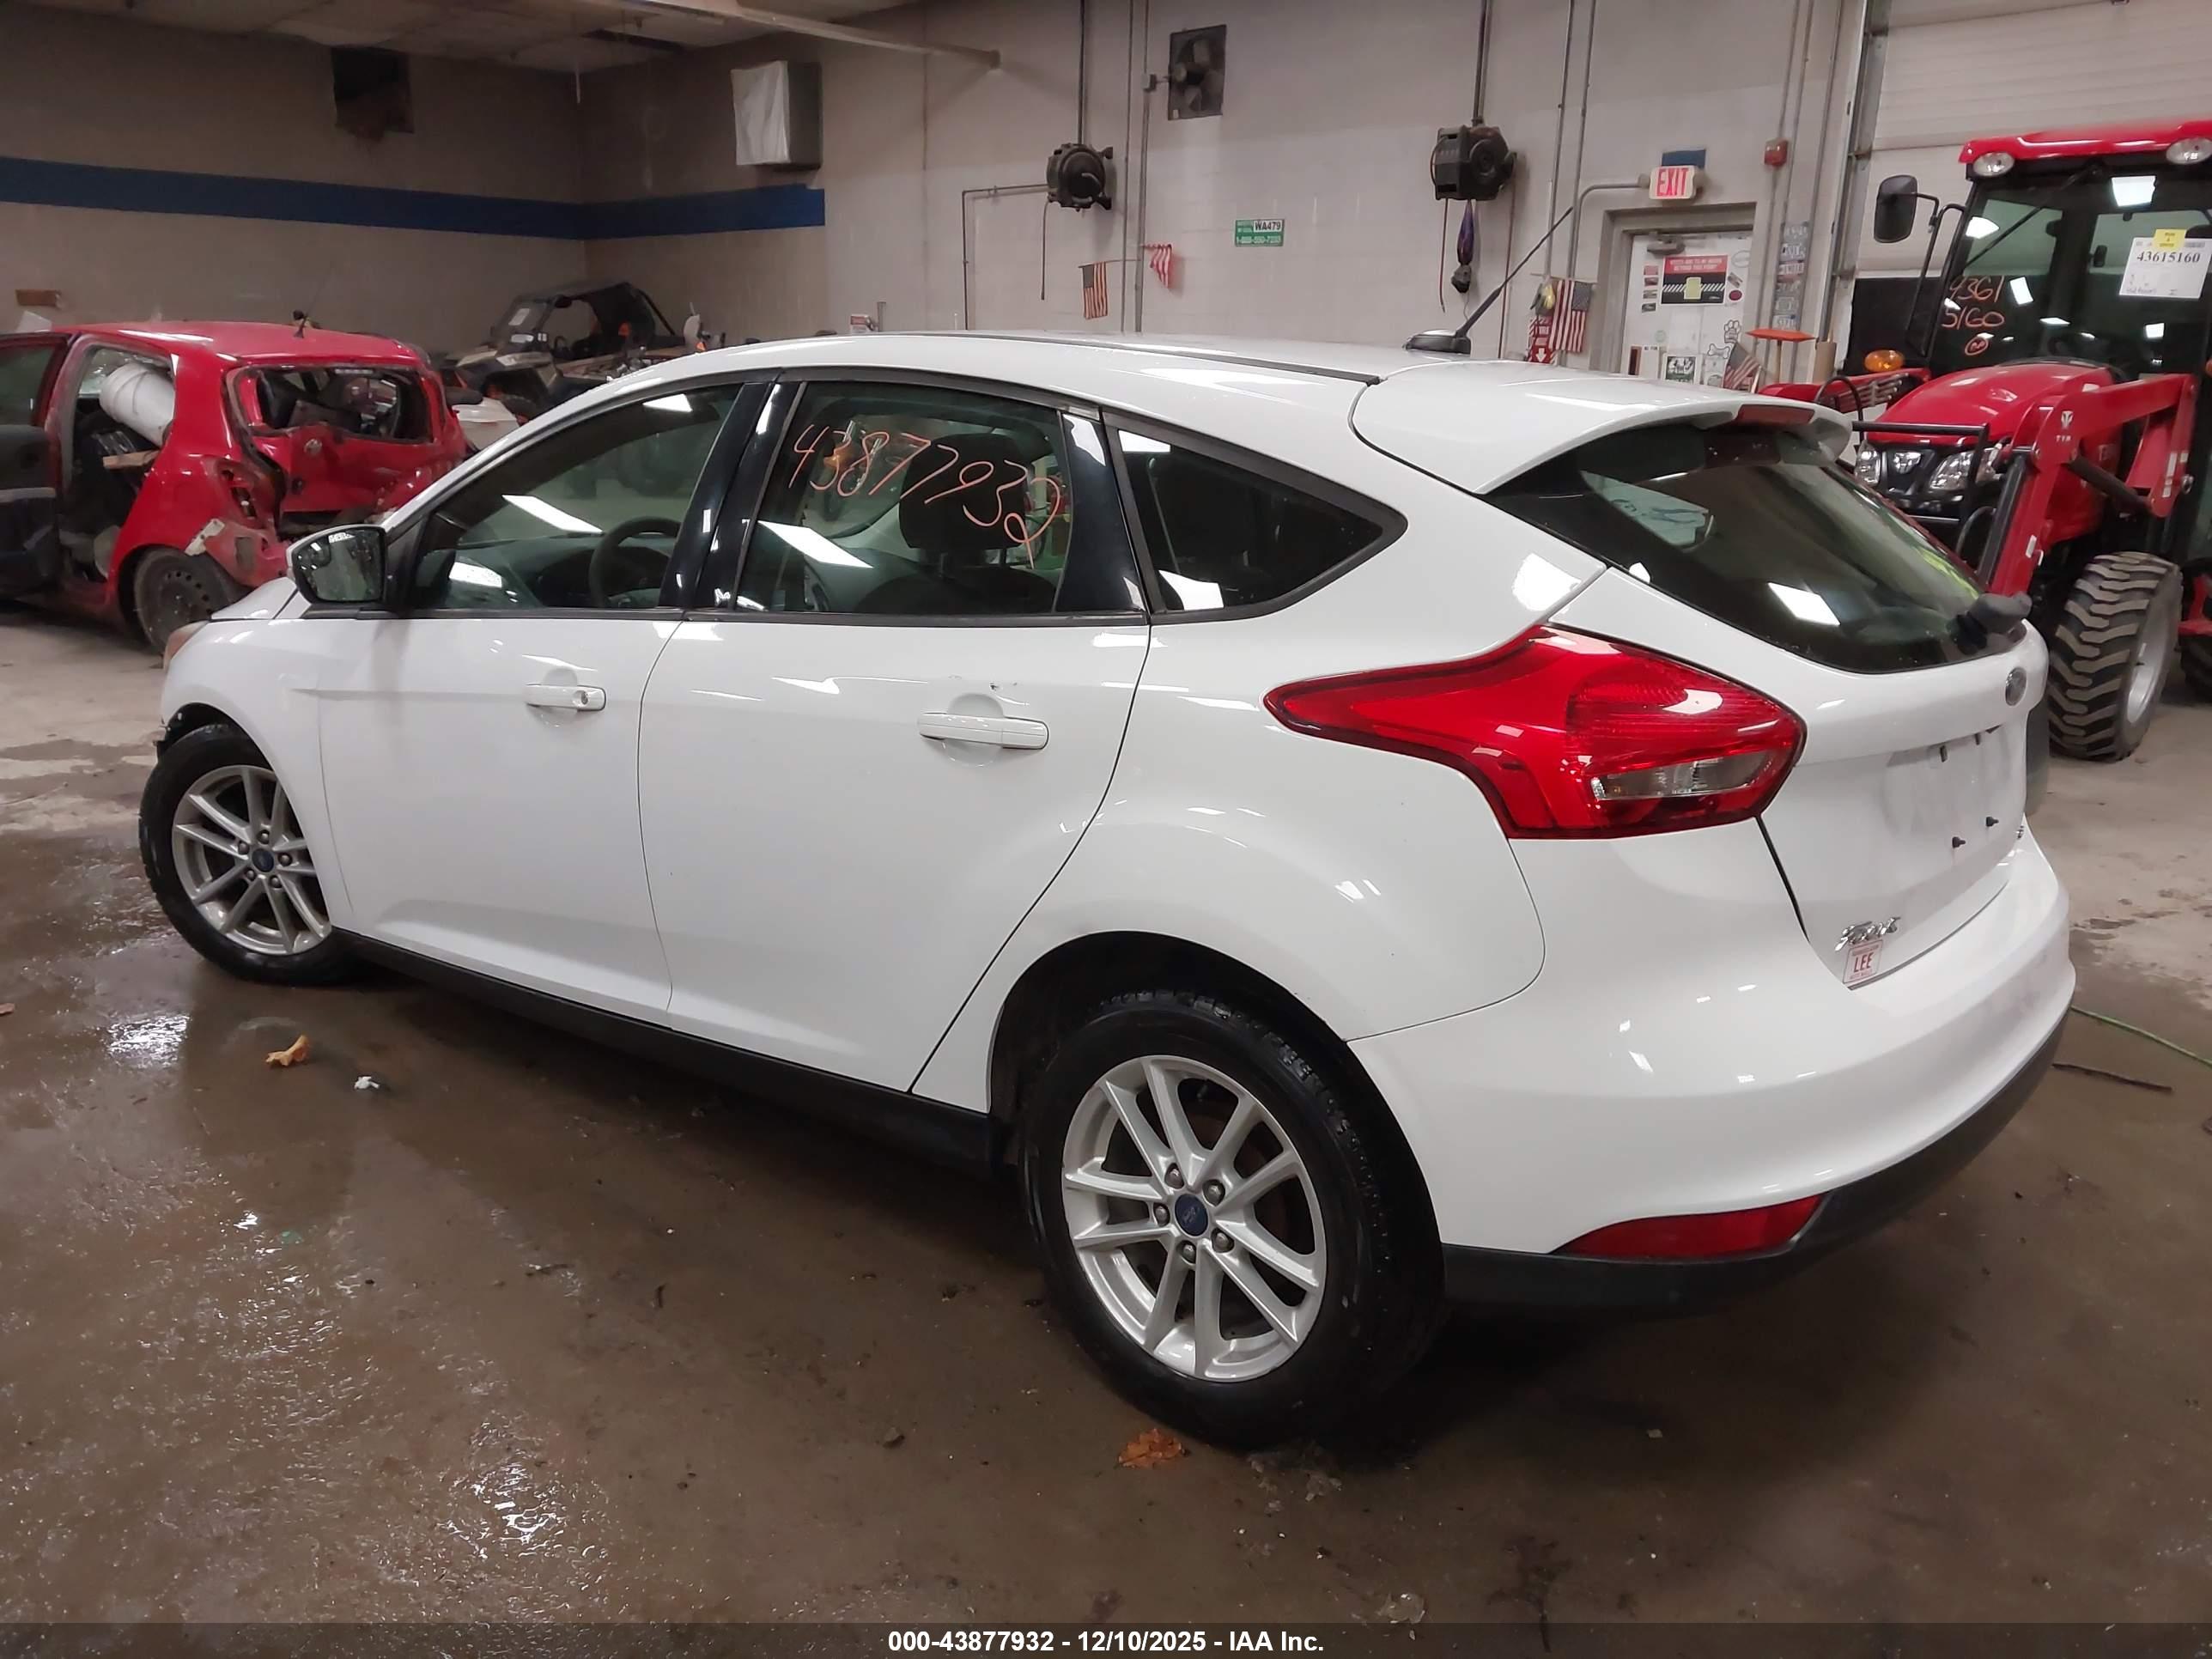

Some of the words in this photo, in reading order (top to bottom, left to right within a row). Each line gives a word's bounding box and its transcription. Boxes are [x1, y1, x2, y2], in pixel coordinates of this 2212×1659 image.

[1656, 167, 1689, 197] EXIT
[1255, 221, 1281, 231] WA479
[2136, 251, 2201, 263] 43615160
[1949, 275, 2005, 303] 4361
[1942, 306, 2005, 331] 5160
[787, 423, 1061, 570] 43877932
[1853, 951, 1875, 974] LEE
